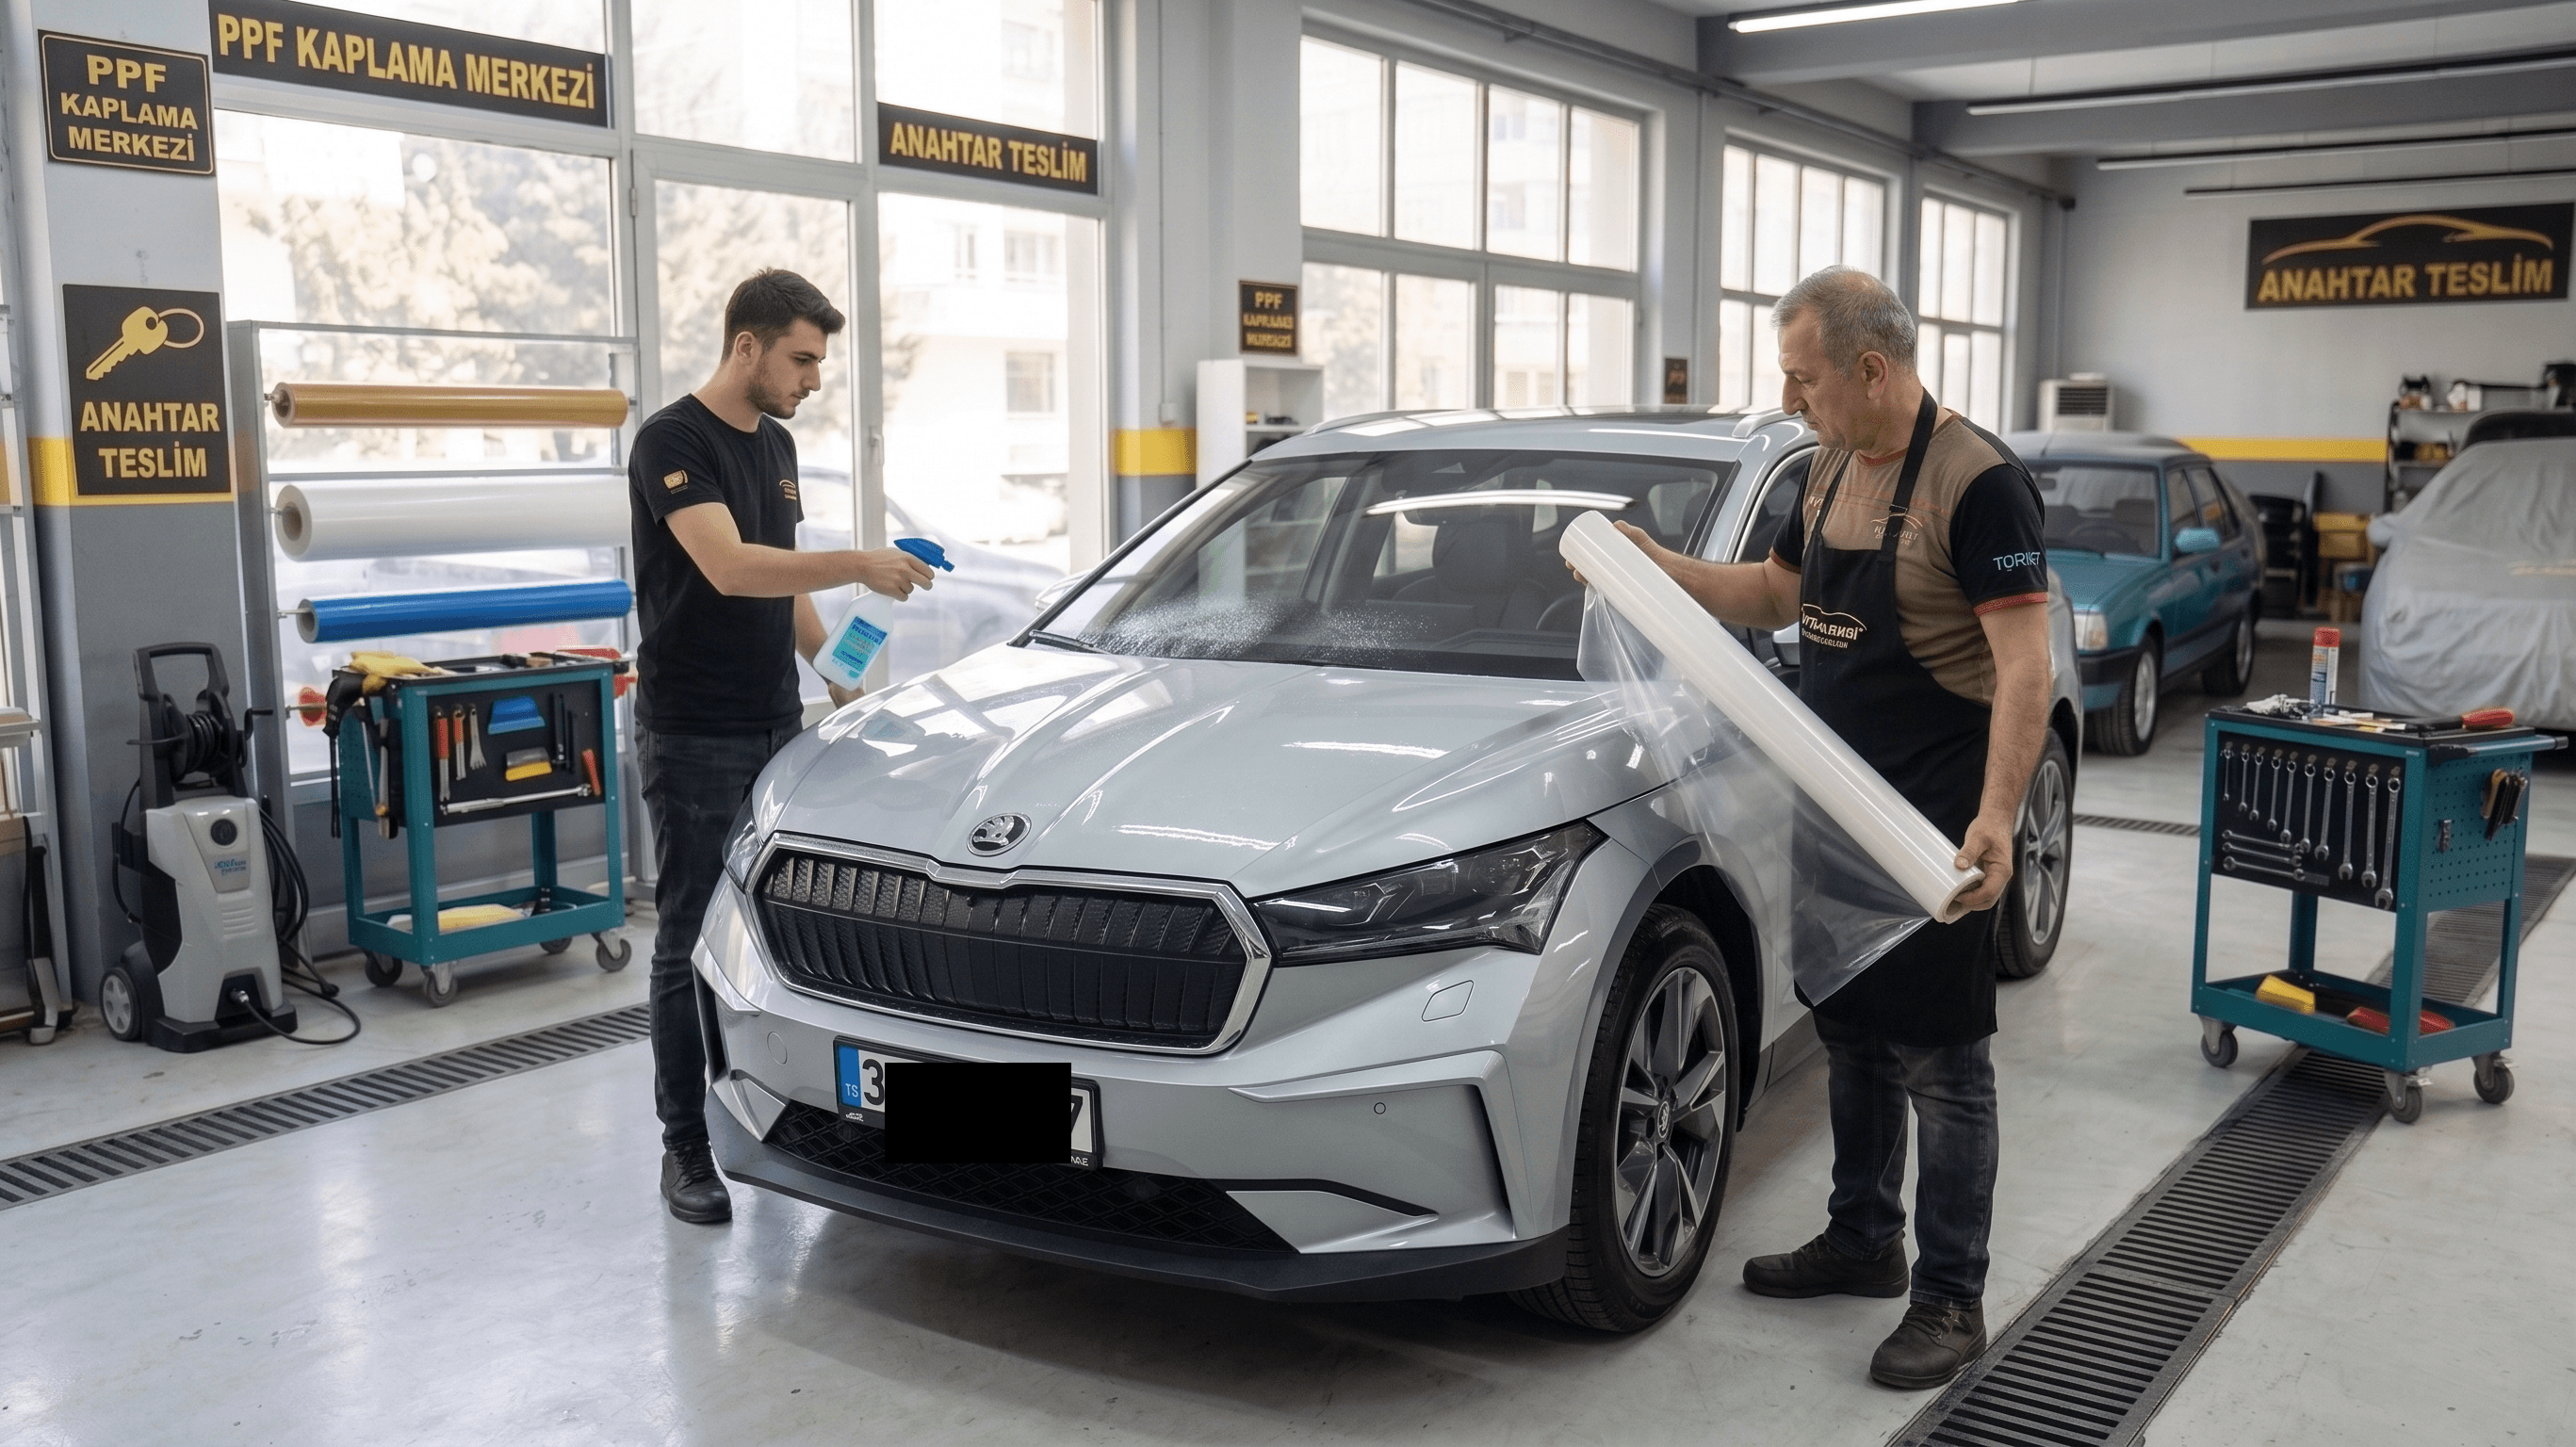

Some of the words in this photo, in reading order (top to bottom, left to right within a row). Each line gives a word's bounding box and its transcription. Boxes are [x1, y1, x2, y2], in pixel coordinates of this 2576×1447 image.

[87, 54, 167, 93] PPF
[218, 13, 284, 63] PPF
[296, 25, 458, 89] KAPLAMA
[465, 53, 595, 109] MERKEZİ
[60, 91, 199, 130] KAPLAMA
[68, 125, 195, 162] MERKEZİ
[889, 122, 1003, 170] ANAHTAR
[1007, 140, 1087, 182] TESLİM
[2257, 265, 2416, 302] ANAHTAR
[2424, 252, 2553, 296] TESLİM
[1254, 291, 1282, 310] PPF
[80, 401, 220, 432] ANAHTAR
[98, 440, 207, 479] TESLİM
[845, 1082, 858, 1097] TS
